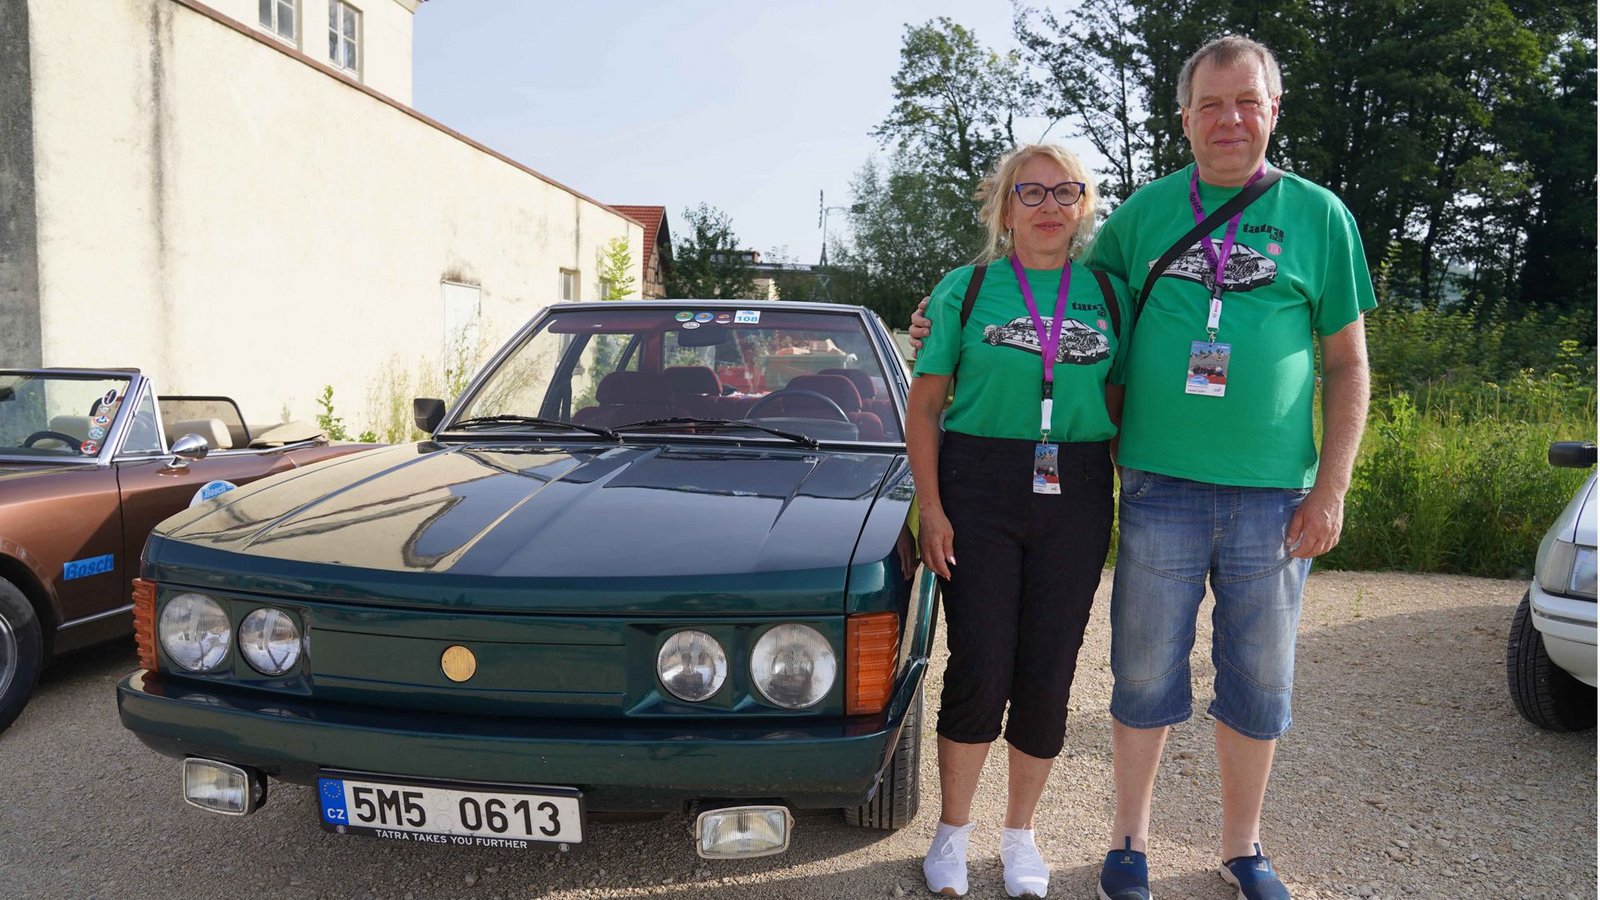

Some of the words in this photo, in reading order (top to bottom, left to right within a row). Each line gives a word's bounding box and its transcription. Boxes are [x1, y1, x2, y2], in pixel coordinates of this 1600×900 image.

[65, 554, 113, 579] Bosch
[327, 808, 345, 820] CZ
[352, 786, 426, 828] 5M5
[458, 796, 561, 837] 0613
[375, 829, 409, 840] TATRA
[412, 832, 447, 843] TAKES
[449, 835, 473, 846] YOU
[476, 837, 528, 849] FURTHER
